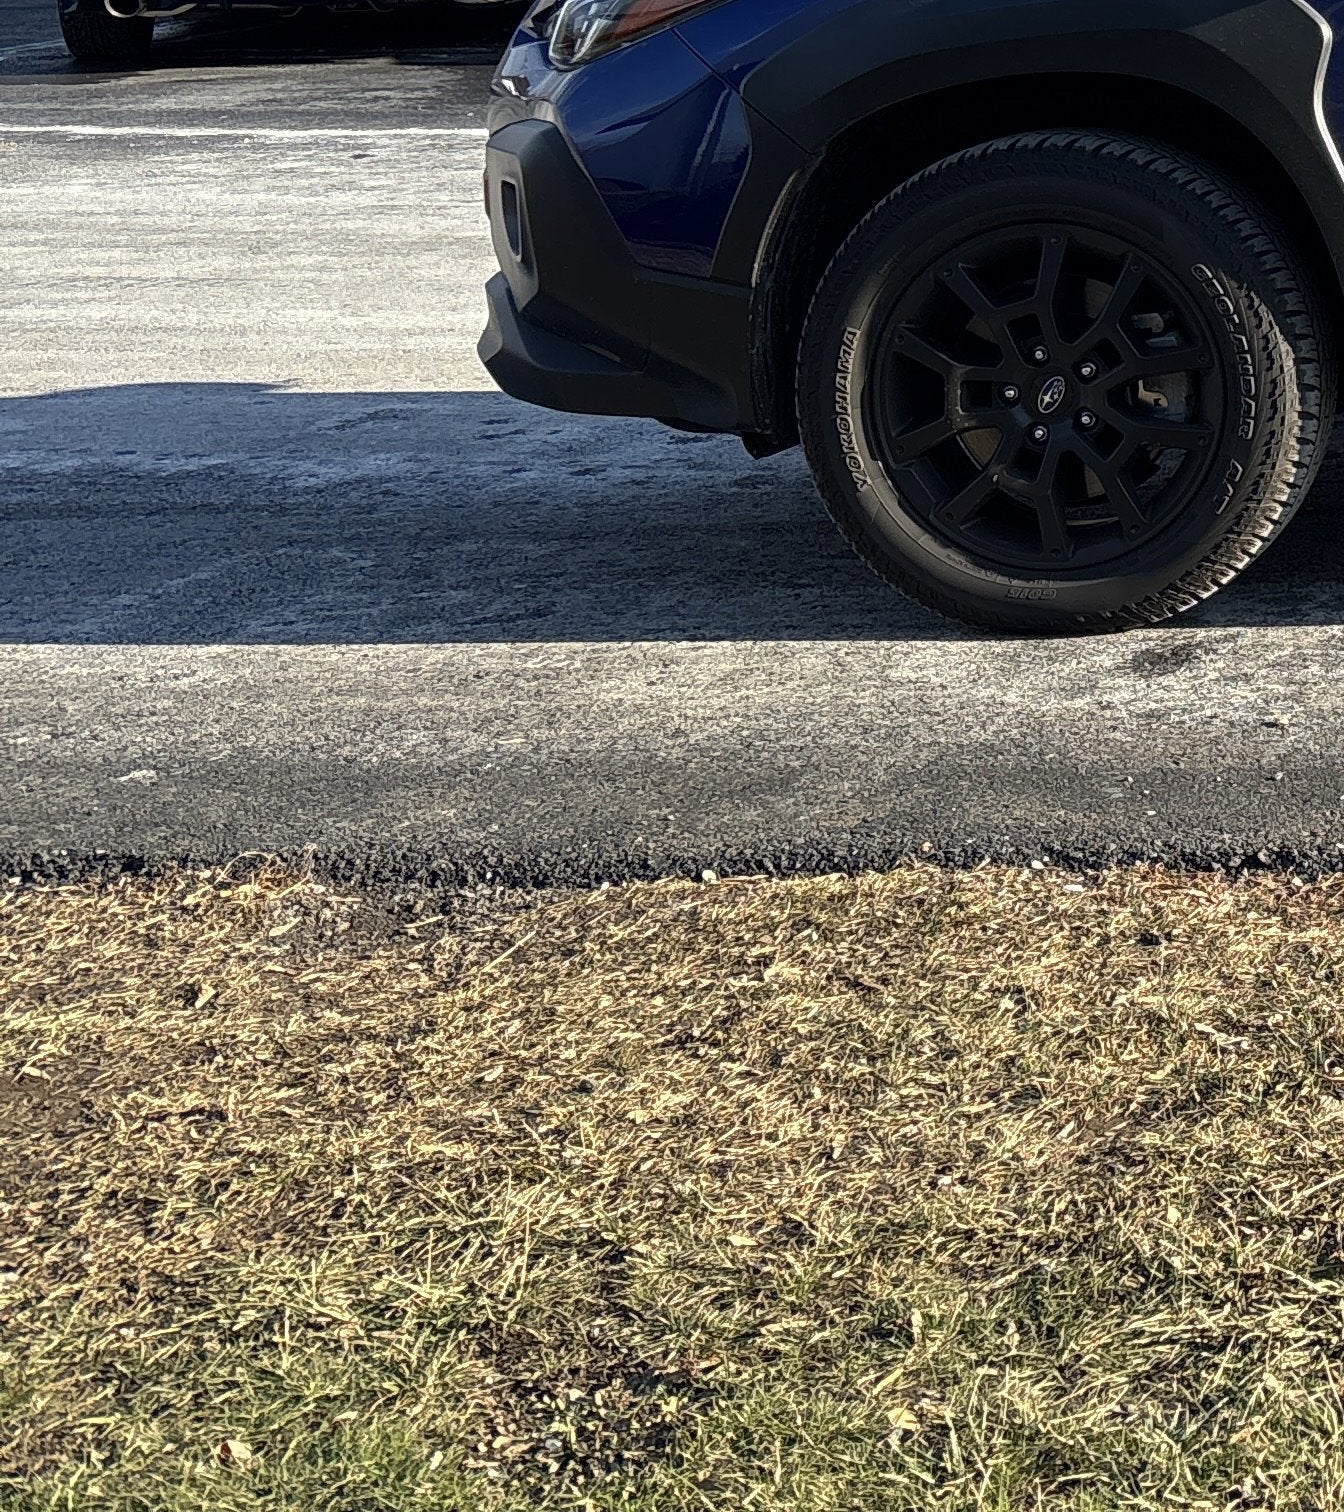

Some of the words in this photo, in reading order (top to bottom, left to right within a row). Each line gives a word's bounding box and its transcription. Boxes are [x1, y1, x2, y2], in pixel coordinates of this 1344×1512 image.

[833, 326, 872, 493] YOKOHAMA
[1191, 263, 1256, 441] GEOLANDAR
[1213, 457, 1244, 516] A/T
